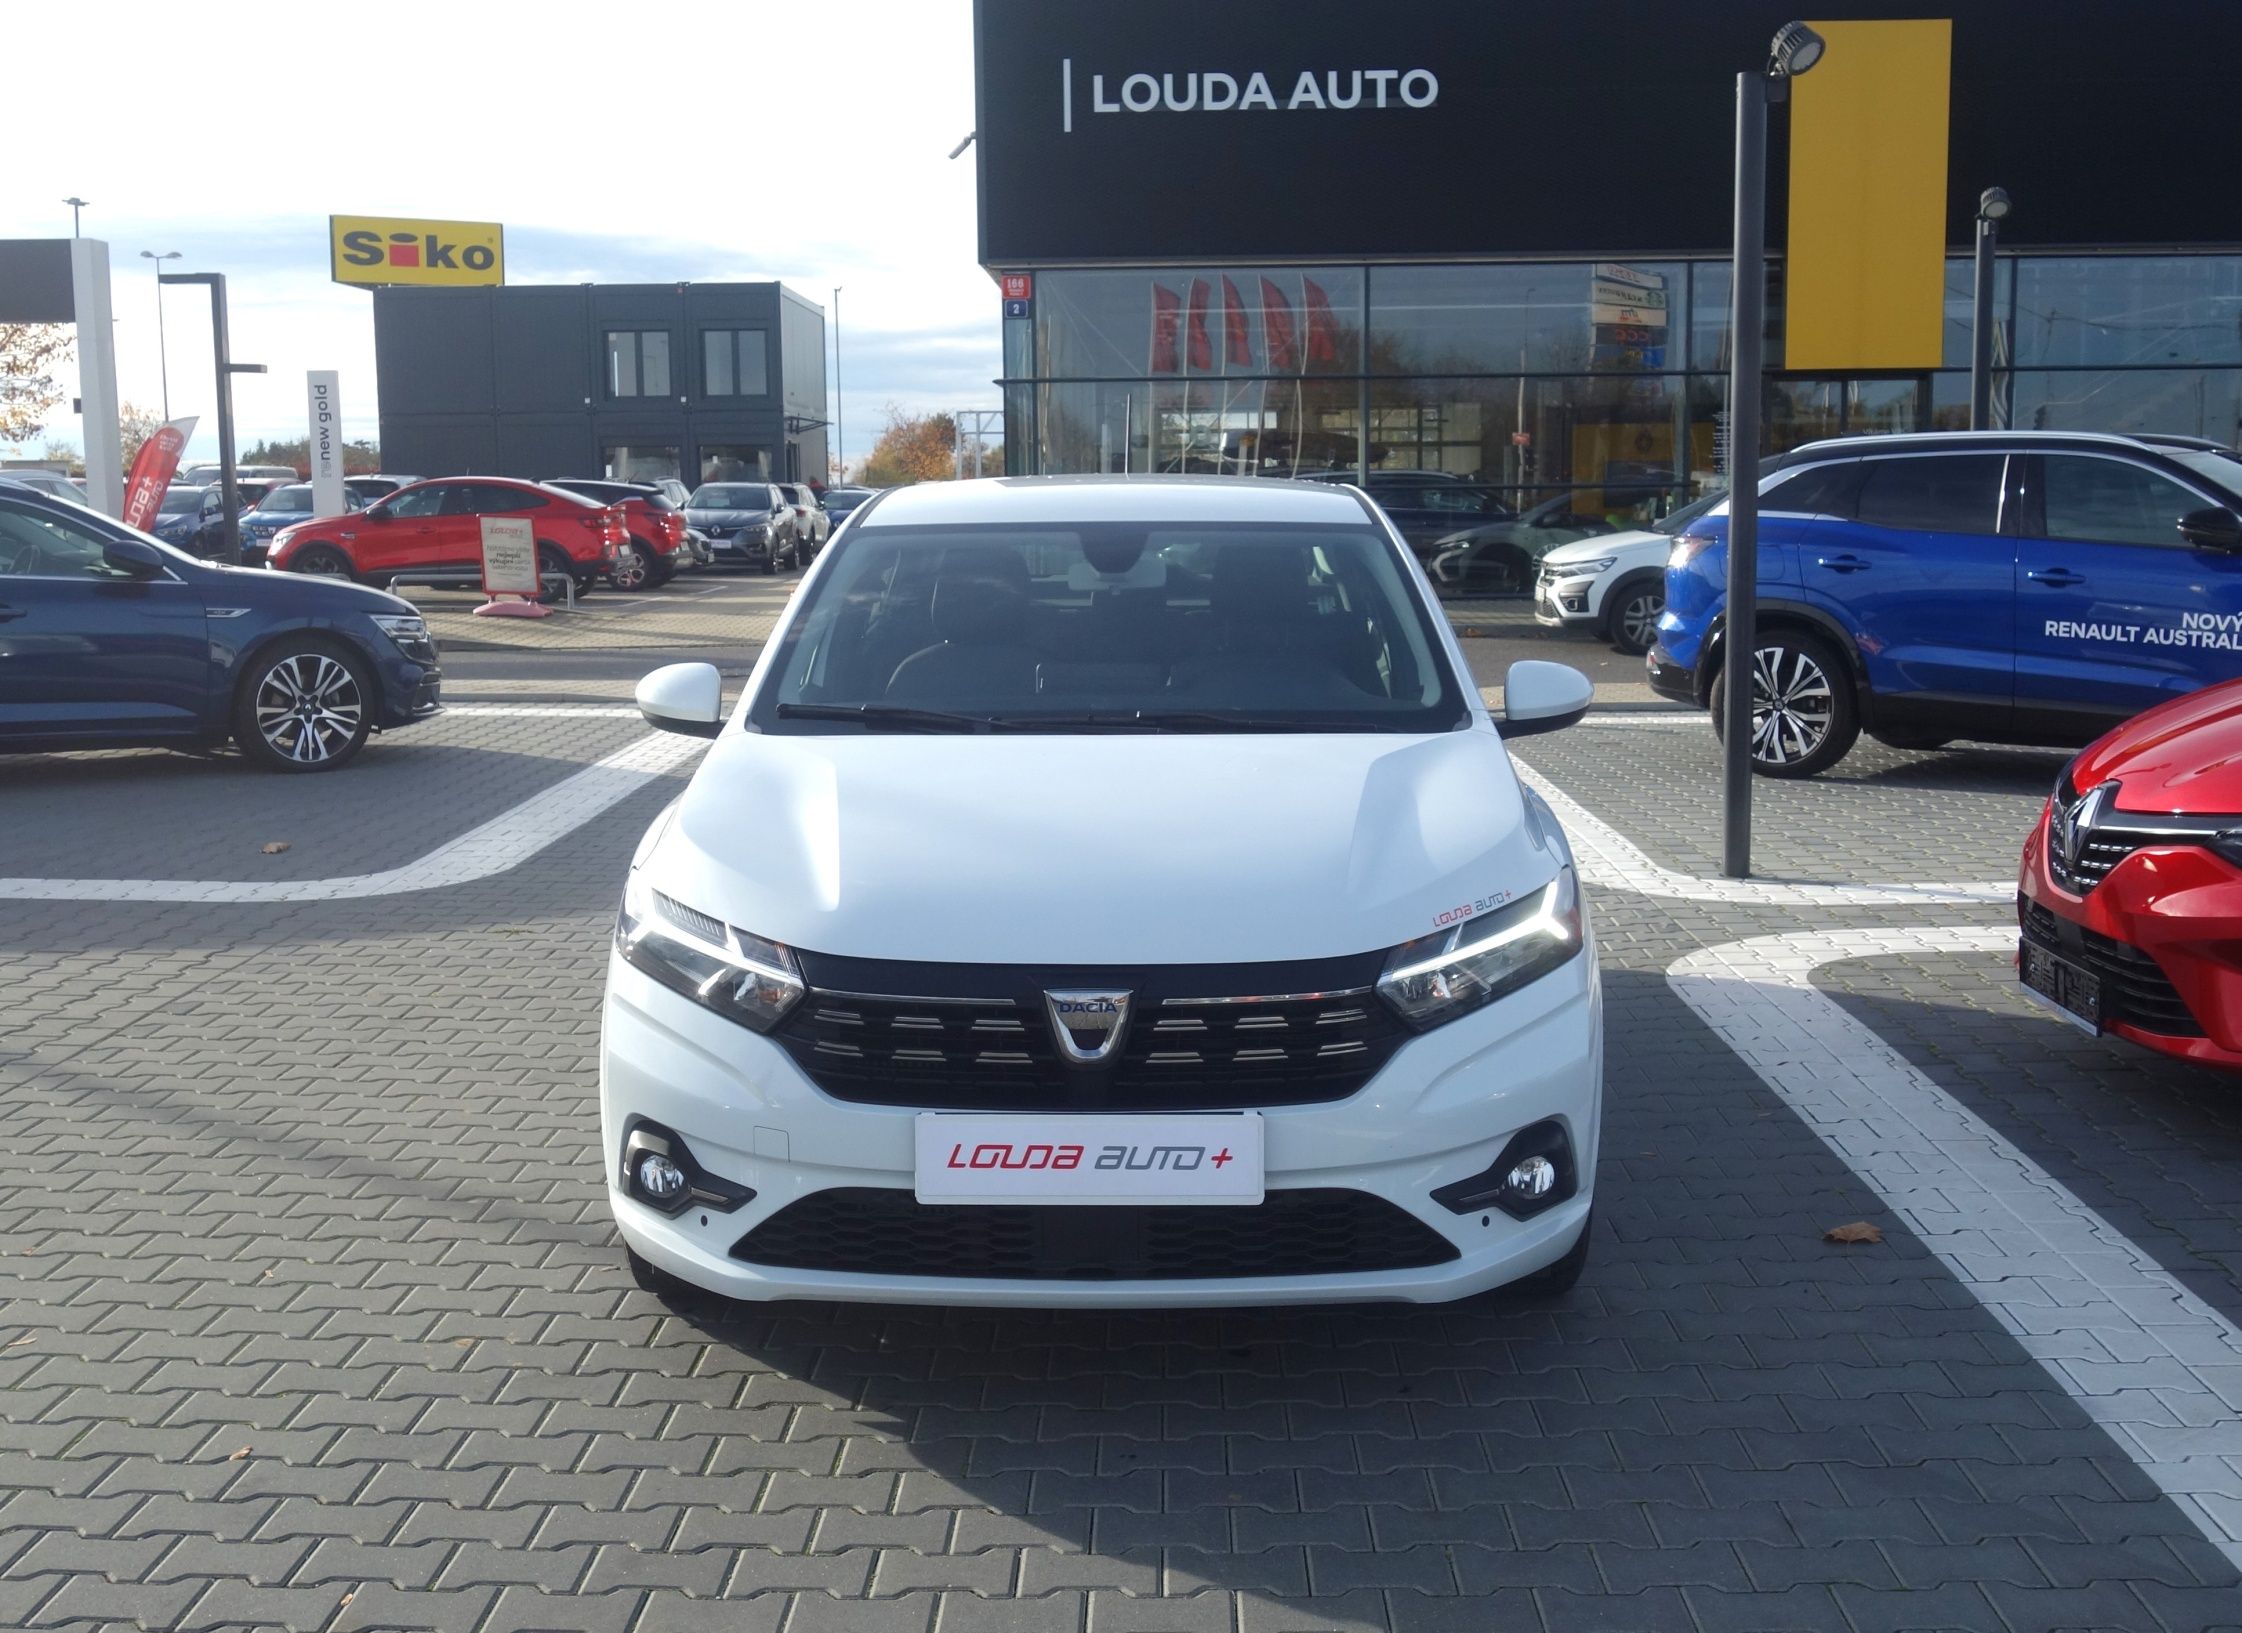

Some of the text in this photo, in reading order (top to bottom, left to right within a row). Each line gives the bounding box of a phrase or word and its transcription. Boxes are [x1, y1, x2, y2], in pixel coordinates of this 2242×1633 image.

[1093, 68, 1440, 113] LOUDA AUTO
[342, 230, 496, 271] Siko
[1013, 303, 1020, 314] 2
[314, 384, 332, 423] gold
[2044, 619, 2242, 651] RENAULT AUSTRAL
[1059, 1002, 1118, 1013] DACIA
